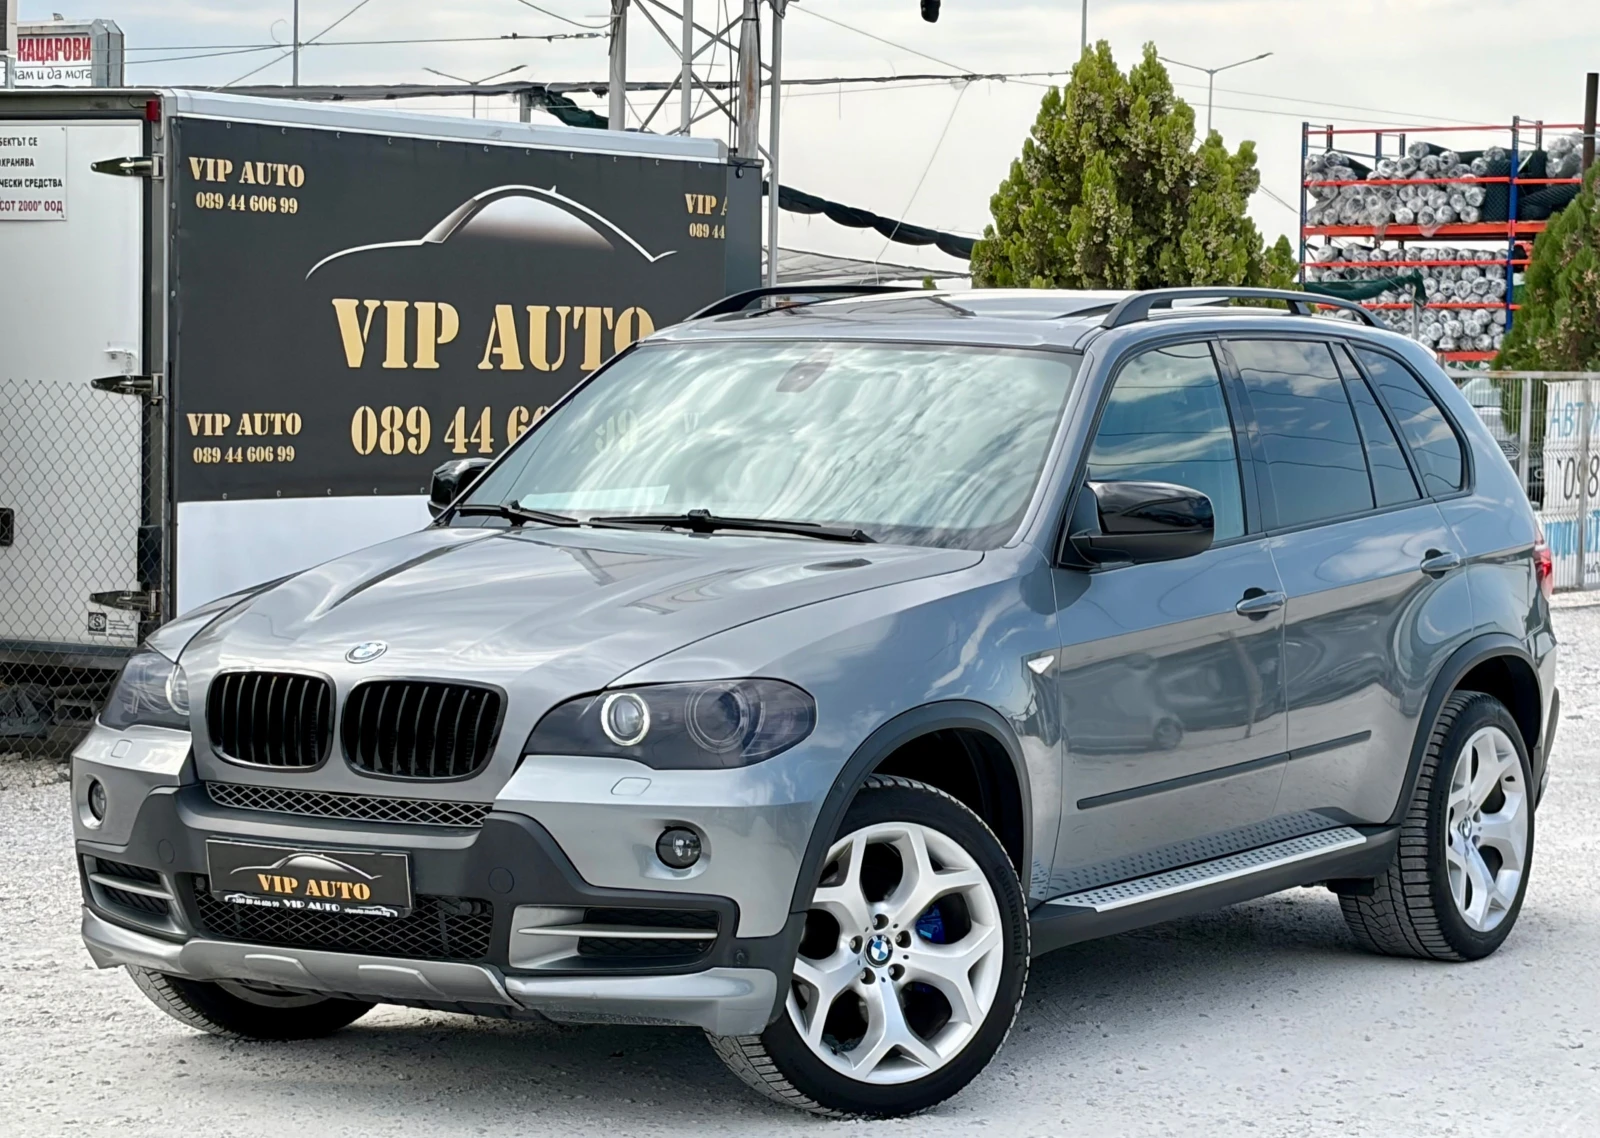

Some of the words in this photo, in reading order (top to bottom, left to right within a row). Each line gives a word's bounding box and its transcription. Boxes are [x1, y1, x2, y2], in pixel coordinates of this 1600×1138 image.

[17, 37, 92, 65] КАЦАРОВИ
[28, 136, 38, 147] СЕ
[0, 157, 35, 167] ХРАНЯВА
[188, 156, 233, 182] VIP
[238, 161, 305, 188] AUTO
[24, 178, 63, 189] СРЕДСТВА
[44, 200, 63, 214] ООД
[195, 191, 224, 210] 089
[227, 193, 246, 211] 44
[249, 195, 277, 213] 606
[280, 197, 298, 214] 99
[684, 193, 717, 215] VIP
[689, 222, 710, 238] 089
[711, 224, 725, 239] 44
[331, 298, 460, 369] VIP
[186, 413, 231, 436] VIP
[236, 412, 302, 436] AUTO
[351, 405, 431, 456] 089
[443, 406, 495, 454] 44
[193, 446, 221, 464] 089
[224, 446, 244, 463] 44
[246, 446, 274, 463] 606
[277, 445, 295, 462] 99
[257, 873, 299, 894] VIP
[305, 879, 371, 901] AUTO
[282, 899, 305, 909] VIP
[307, 901, 340, 912] AUTO
